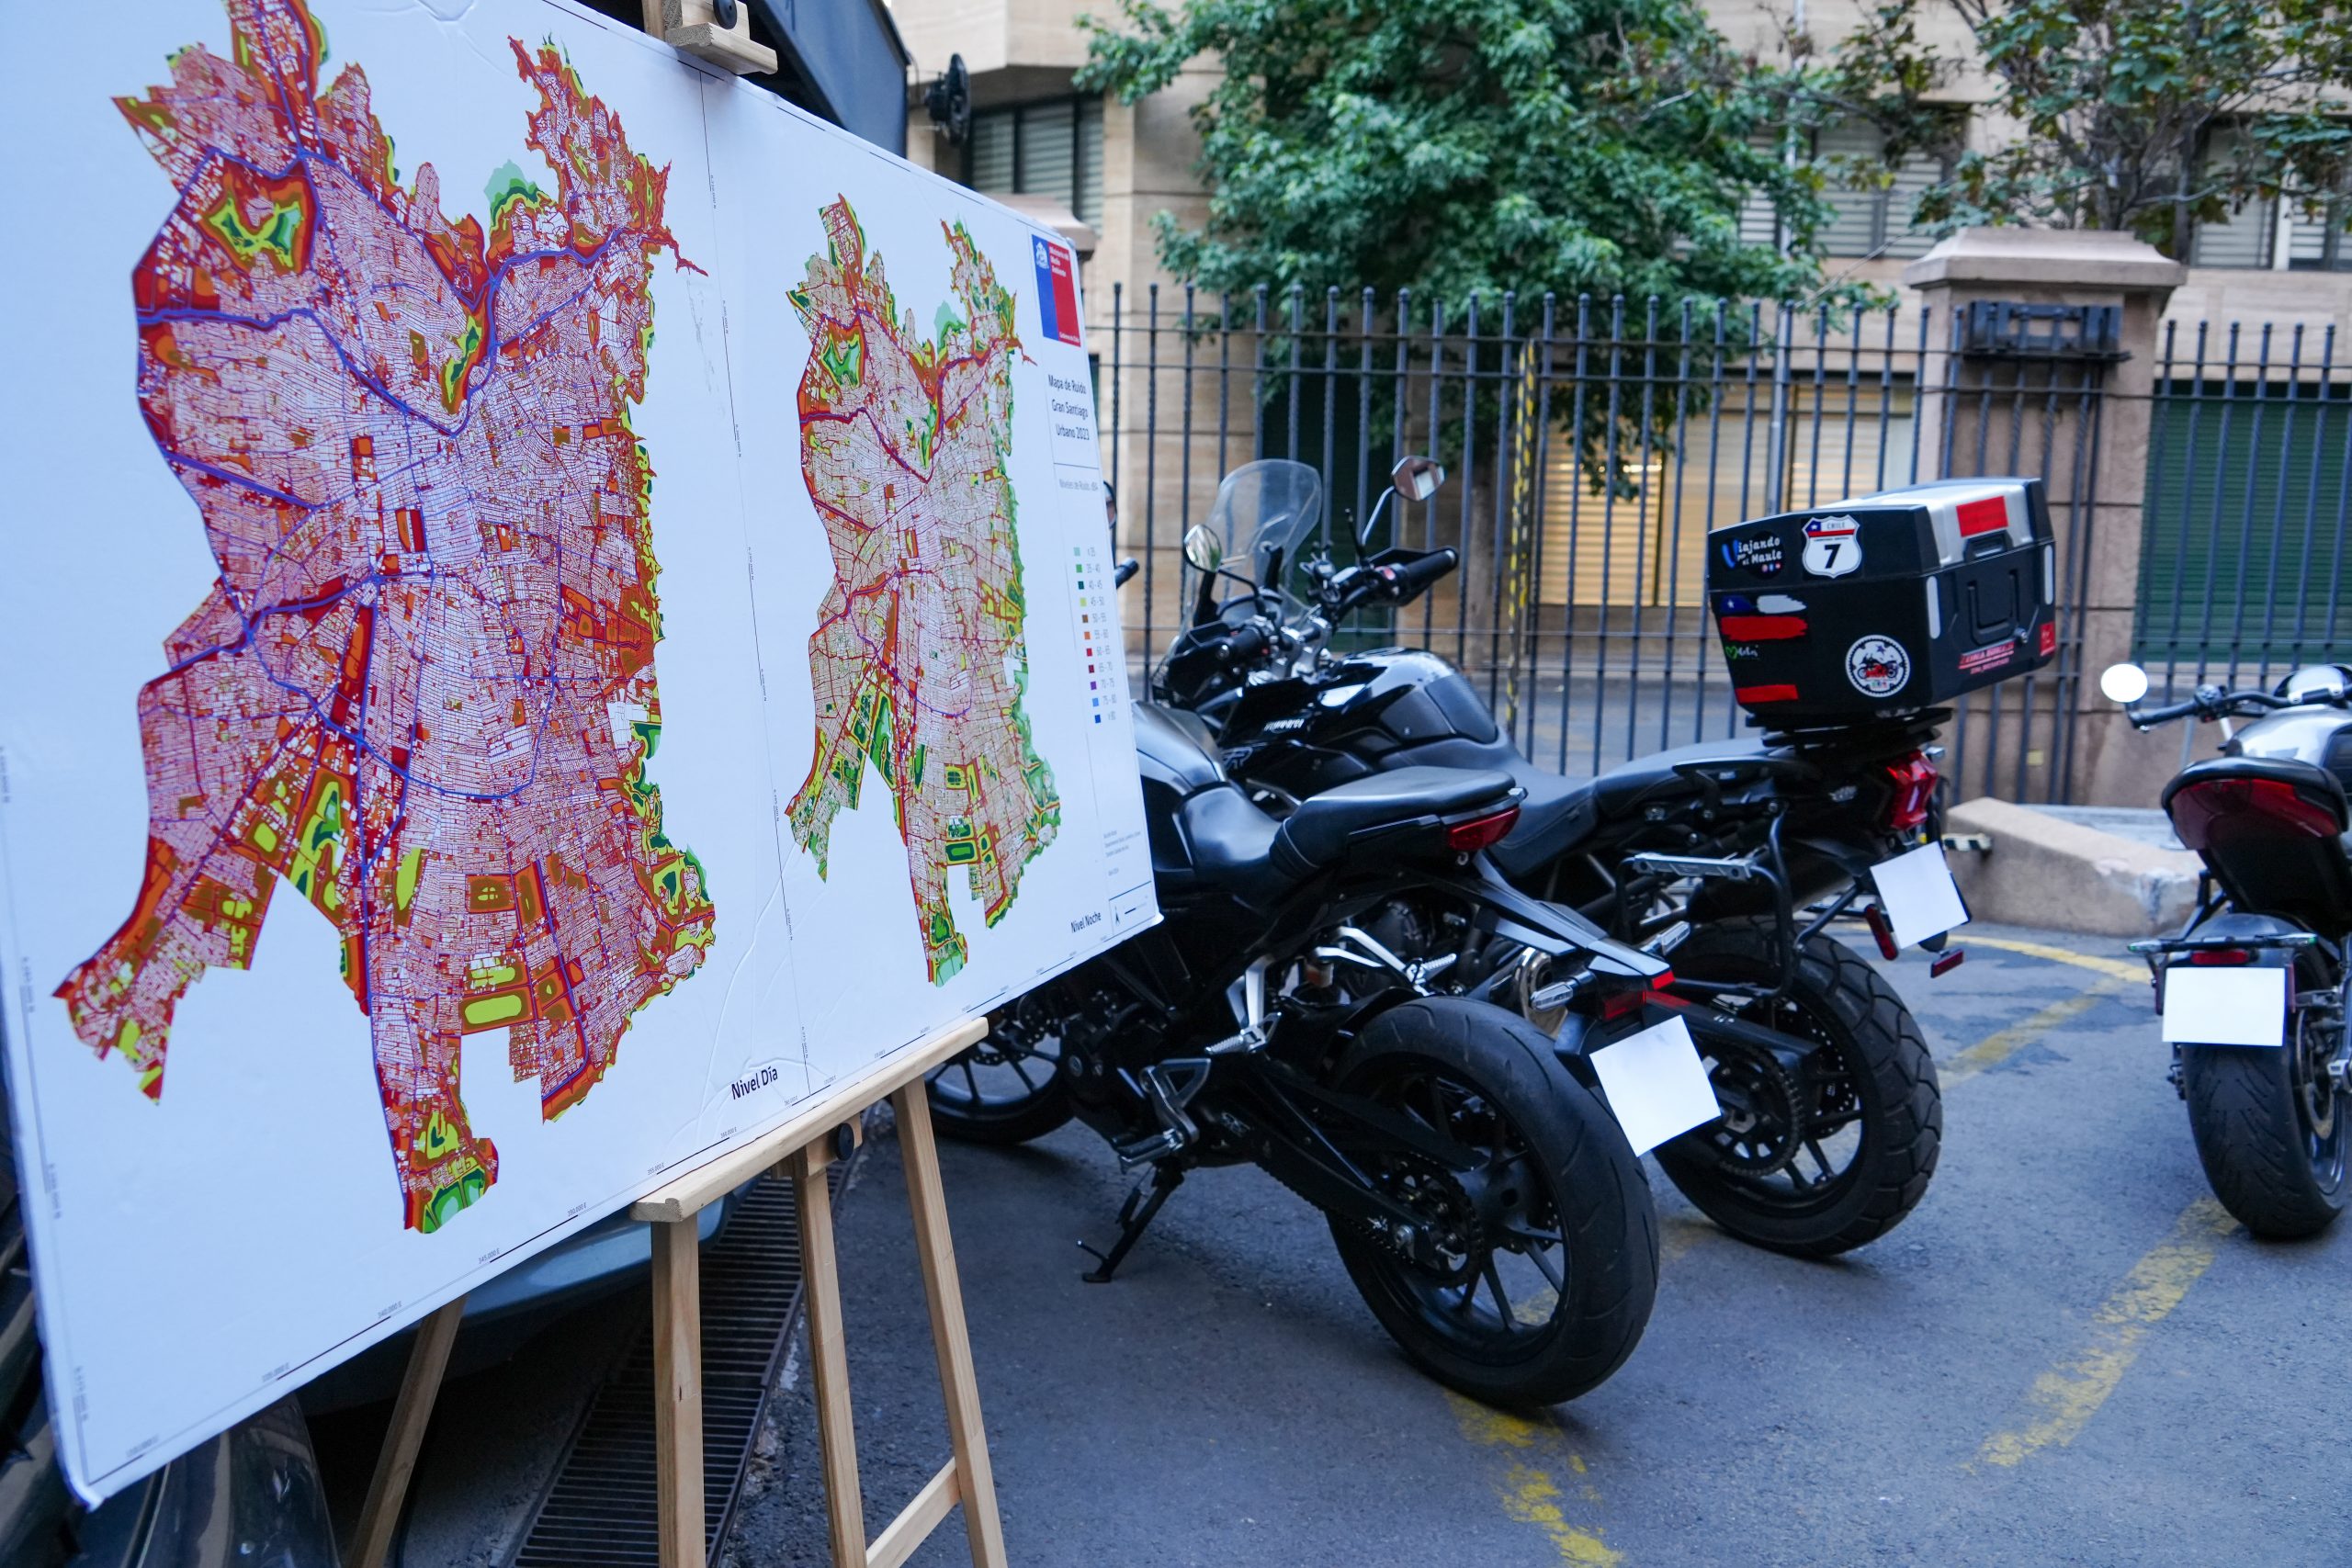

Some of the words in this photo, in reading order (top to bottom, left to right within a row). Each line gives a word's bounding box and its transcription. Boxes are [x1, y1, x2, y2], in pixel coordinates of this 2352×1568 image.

[1048, 374, 1064, 391] Mapa
[1064, 378, 1071, 391] de
[1071, 379, 1086, 394] Ruido
[1052, 399, 1065, 412] Gran
[1066, 401, 1088, 420] Santiago
[1056, 423, 1076, 438] Urbano
[1076, 427, 1090, 440] 2023
[1751, 549, 1782, 564] Maule
[1825, 544, 1841, 569] 7
[1070, 918, 1085, 932] Nivel
[1085, 911, 1101, 926] Noche
[731, 1073, 761, 1100] Nivel
[761, 1066, 778, 1086] Día
